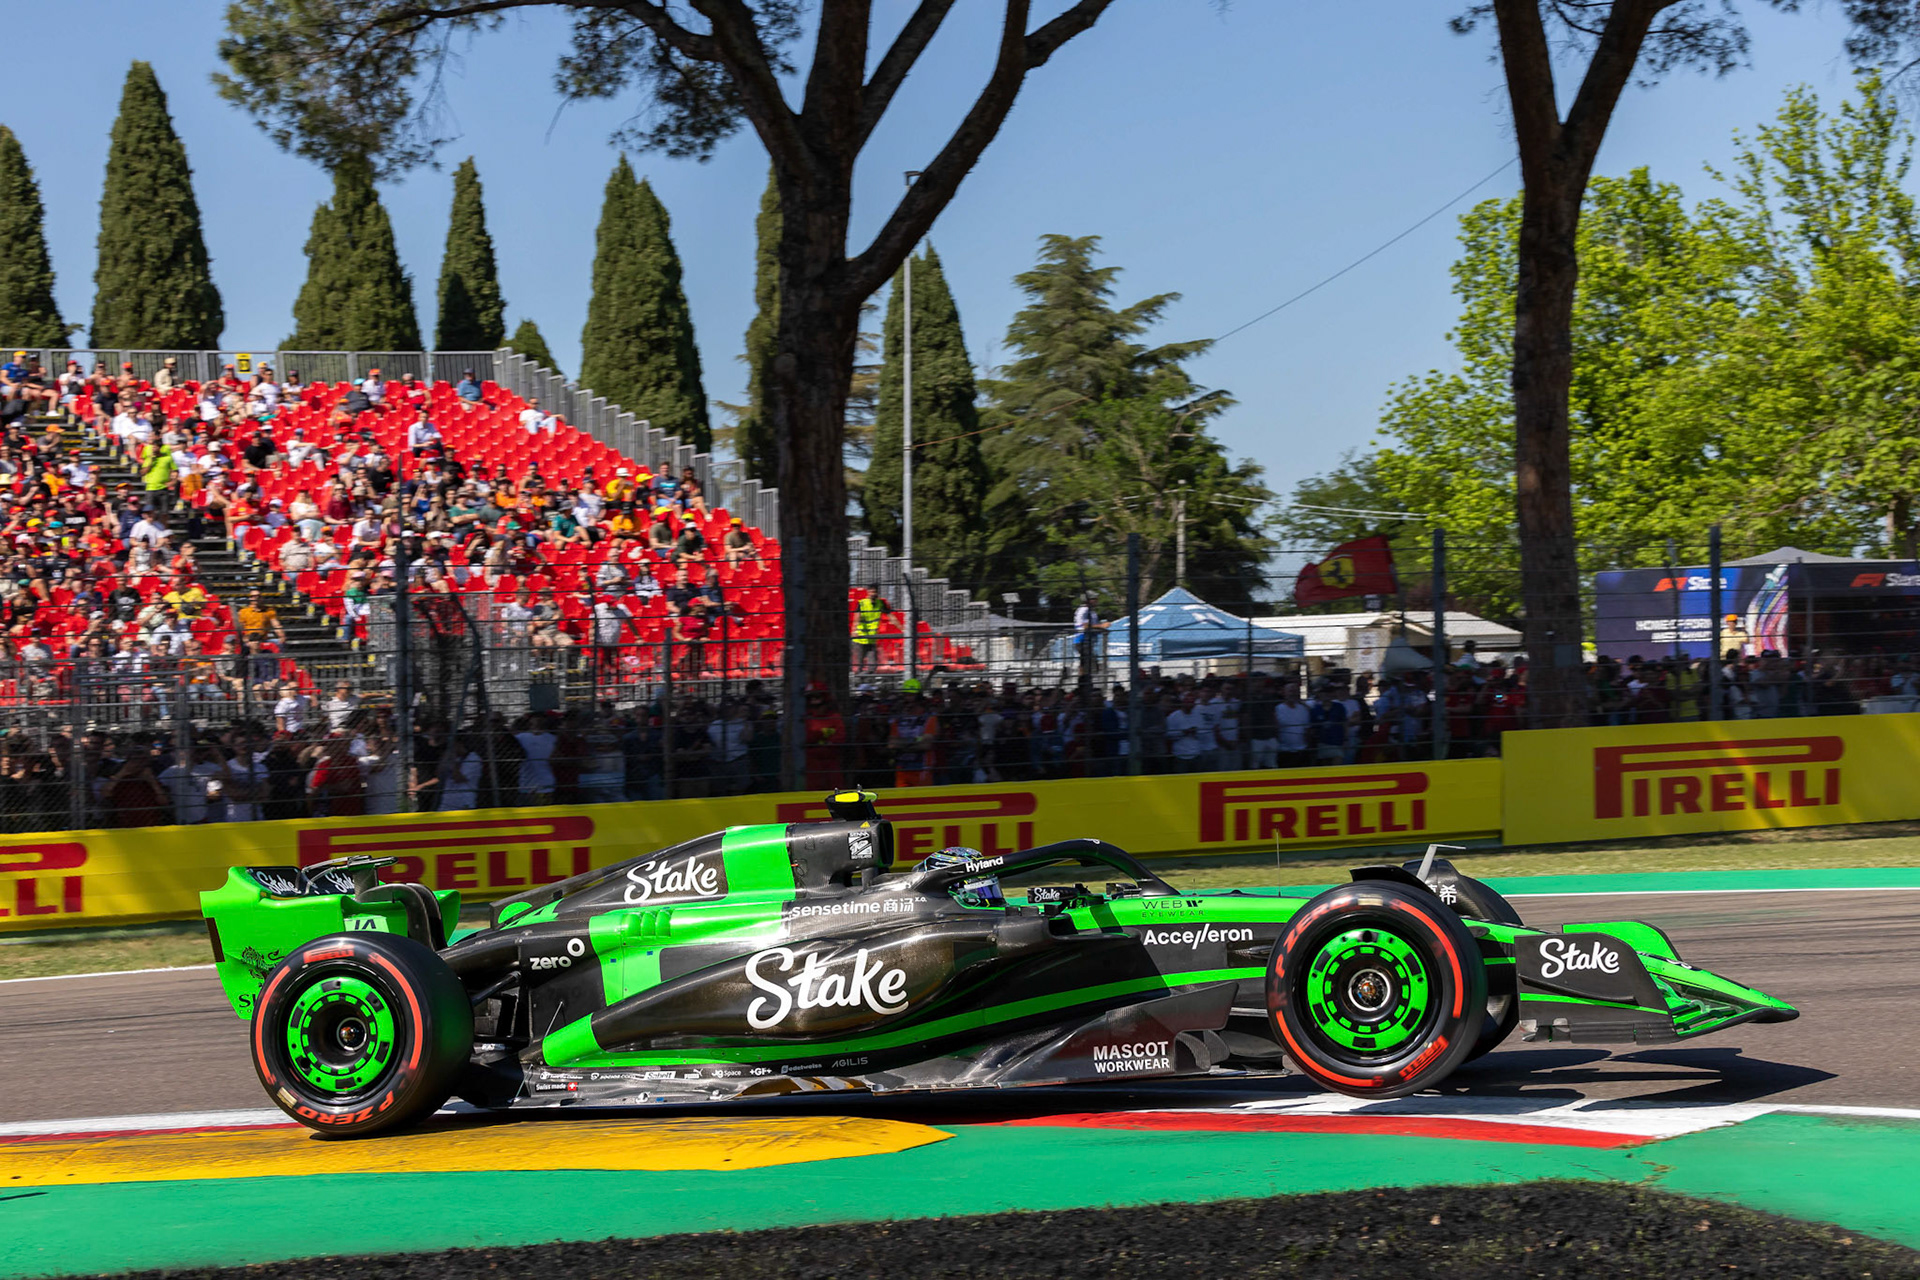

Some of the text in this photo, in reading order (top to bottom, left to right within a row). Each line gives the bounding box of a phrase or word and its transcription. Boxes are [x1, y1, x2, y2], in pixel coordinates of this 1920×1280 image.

[1594, 735, 1844, 820] PIRELLI
[1199, 771, 1430, 843] PIRELLI
[777, 791, 1037, 861] PELLI
[297, 816, 595, 891] PRELLI
[965, 856, 1004, 872] Hyland
[256, 870, 302, 895] Stake
[623, 856, 719, 904] Stake
[1034, 887, 1061, 902] Stake
[791, 900, 881, 918] sensetime
[1141, 900, 1183, 909] WEB
[1141, 910, 1204, 918] EYEWEAR
[529, 956, 572, 970] zero
[1539, 938, 1620, 979] Stake
[745, 947, 909, 1029] Stake
[1093, 1041, 1168, 1061] MASCOT
[788, 1063, 823, 1072] edelweiss
[831, 1057, 869, 1068] AGILIS
[1095, 1058, 1170, 1073] WORKWEAR
[535, 1082, 566, 1091] Swiss made
[296, 1091, 394, 1125] P ZERO
